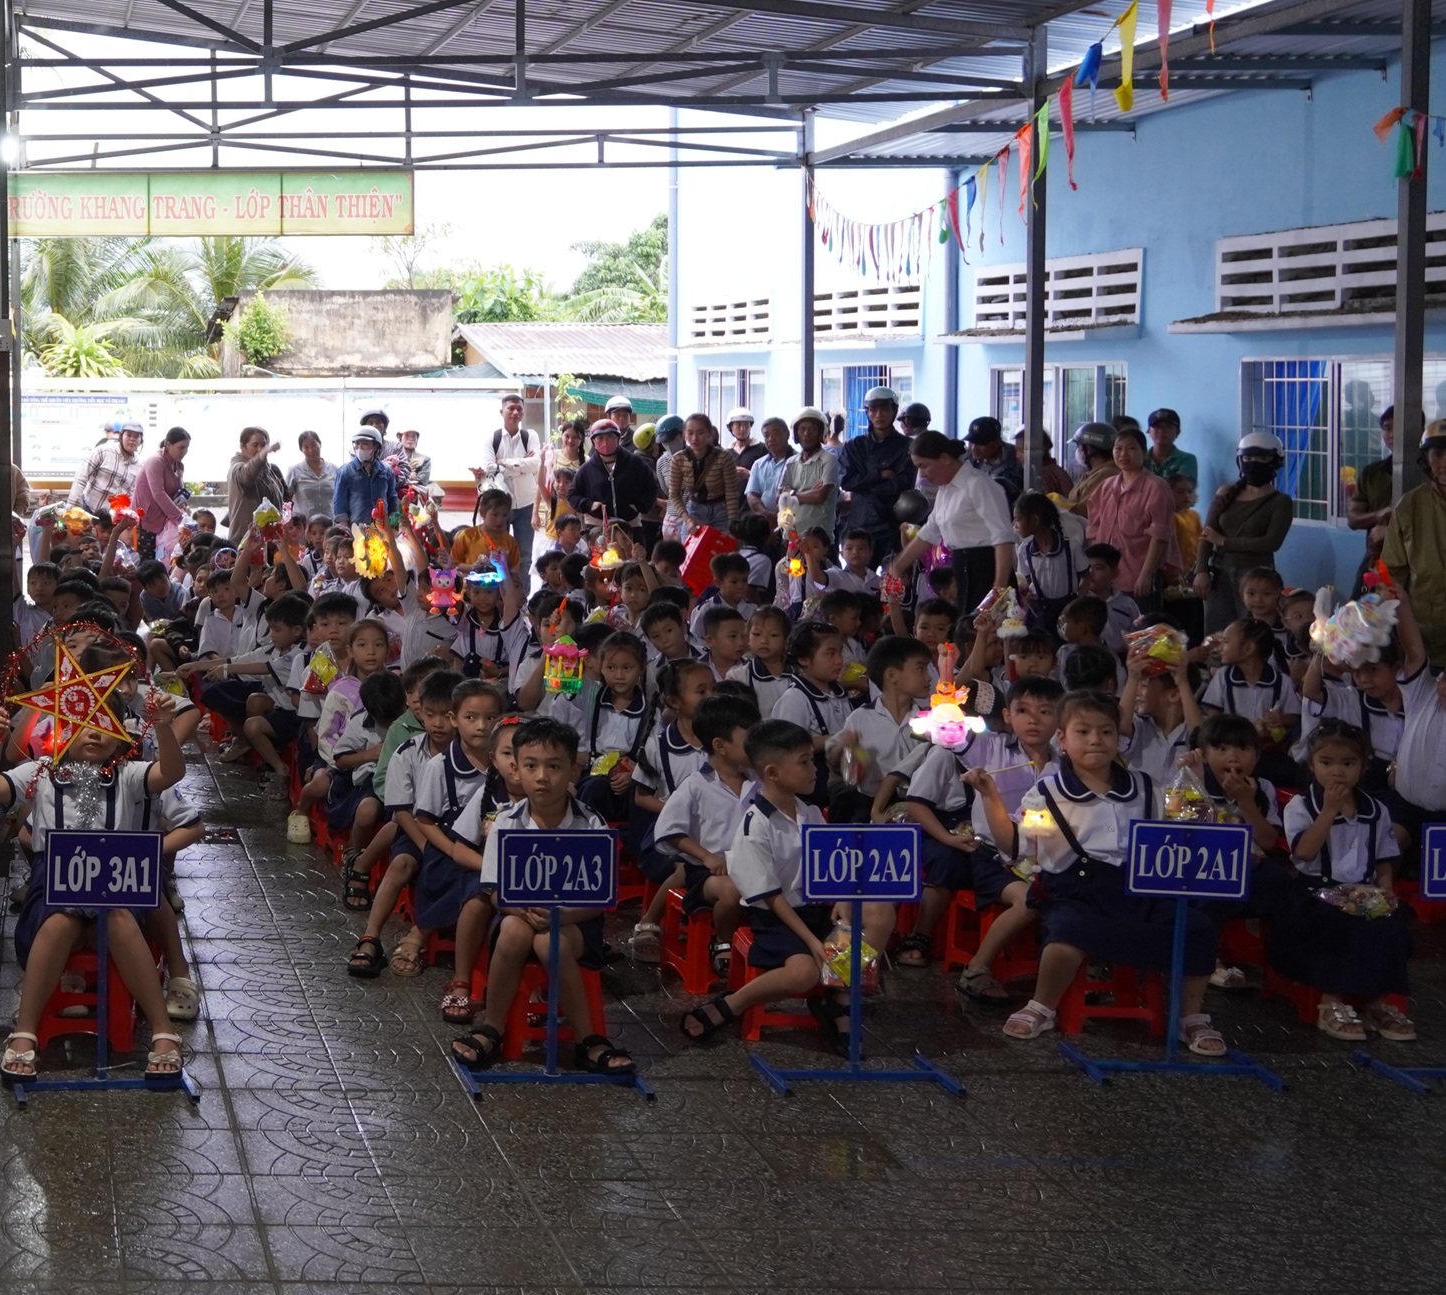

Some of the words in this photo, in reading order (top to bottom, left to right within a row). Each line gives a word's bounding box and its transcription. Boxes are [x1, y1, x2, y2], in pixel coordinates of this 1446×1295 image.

[7, 189, 73, 220] RƯỜNG
[79, 195, 146, 220] KHANG
[152, 195, 216, 220] TRANG
[235, 187, 272, 220] LỚP
[276, 186, 329, 220] THÂN
[53, 846, 102, 892] LỚP
[107, 855, 152, 893] 3A1
[508, 844, 558, 891] LỚP
[561, 854, 603, 891] 2A3
[812, 839, 864, 882] LỚP
[868, 849, 912, 882] 2A2
[1138, 835, 1192, 878] LỚP
[1195, 846, 1239, 881] 2A1
